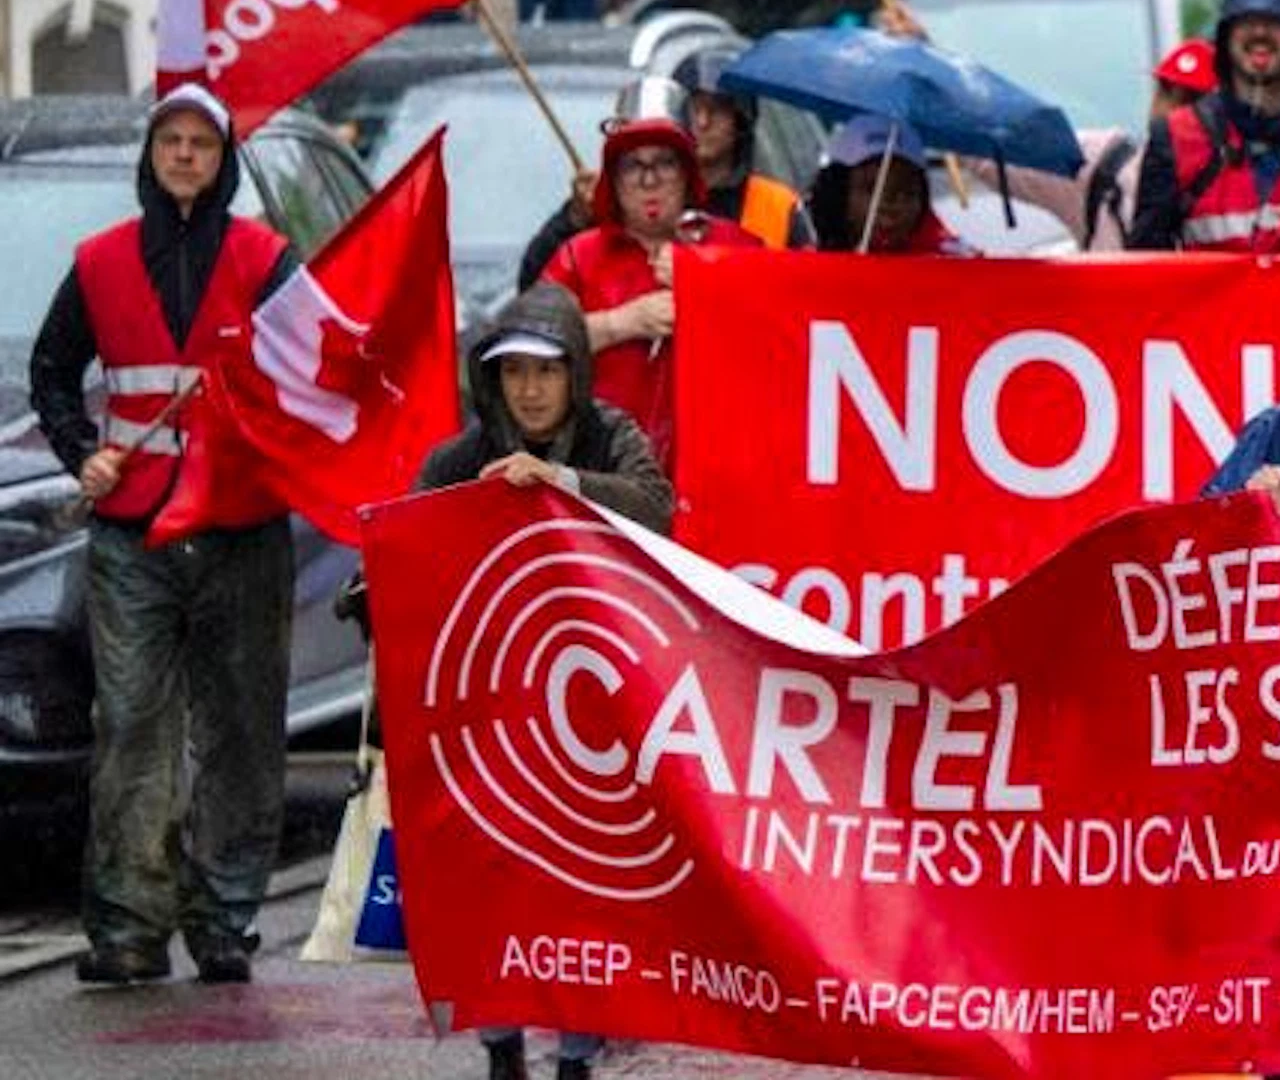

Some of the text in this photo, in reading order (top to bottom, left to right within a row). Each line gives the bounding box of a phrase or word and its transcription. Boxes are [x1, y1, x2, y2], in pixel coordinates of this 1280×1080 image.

[806, 319, 1276, 502] NON
[546, 645, 1043, 811] CARTEL
[1150, 667, 1241, 766] LES
[741, 807, 1236, 887] INTERSYNDICAL
[500, 934, 633, 986] AGEEP
[669, 949, 781, 1013] FAMCO
[815, 978, 1116, 1034] FAPCEGM/HEM
[1213, 976, 1271, 1024] SIT
